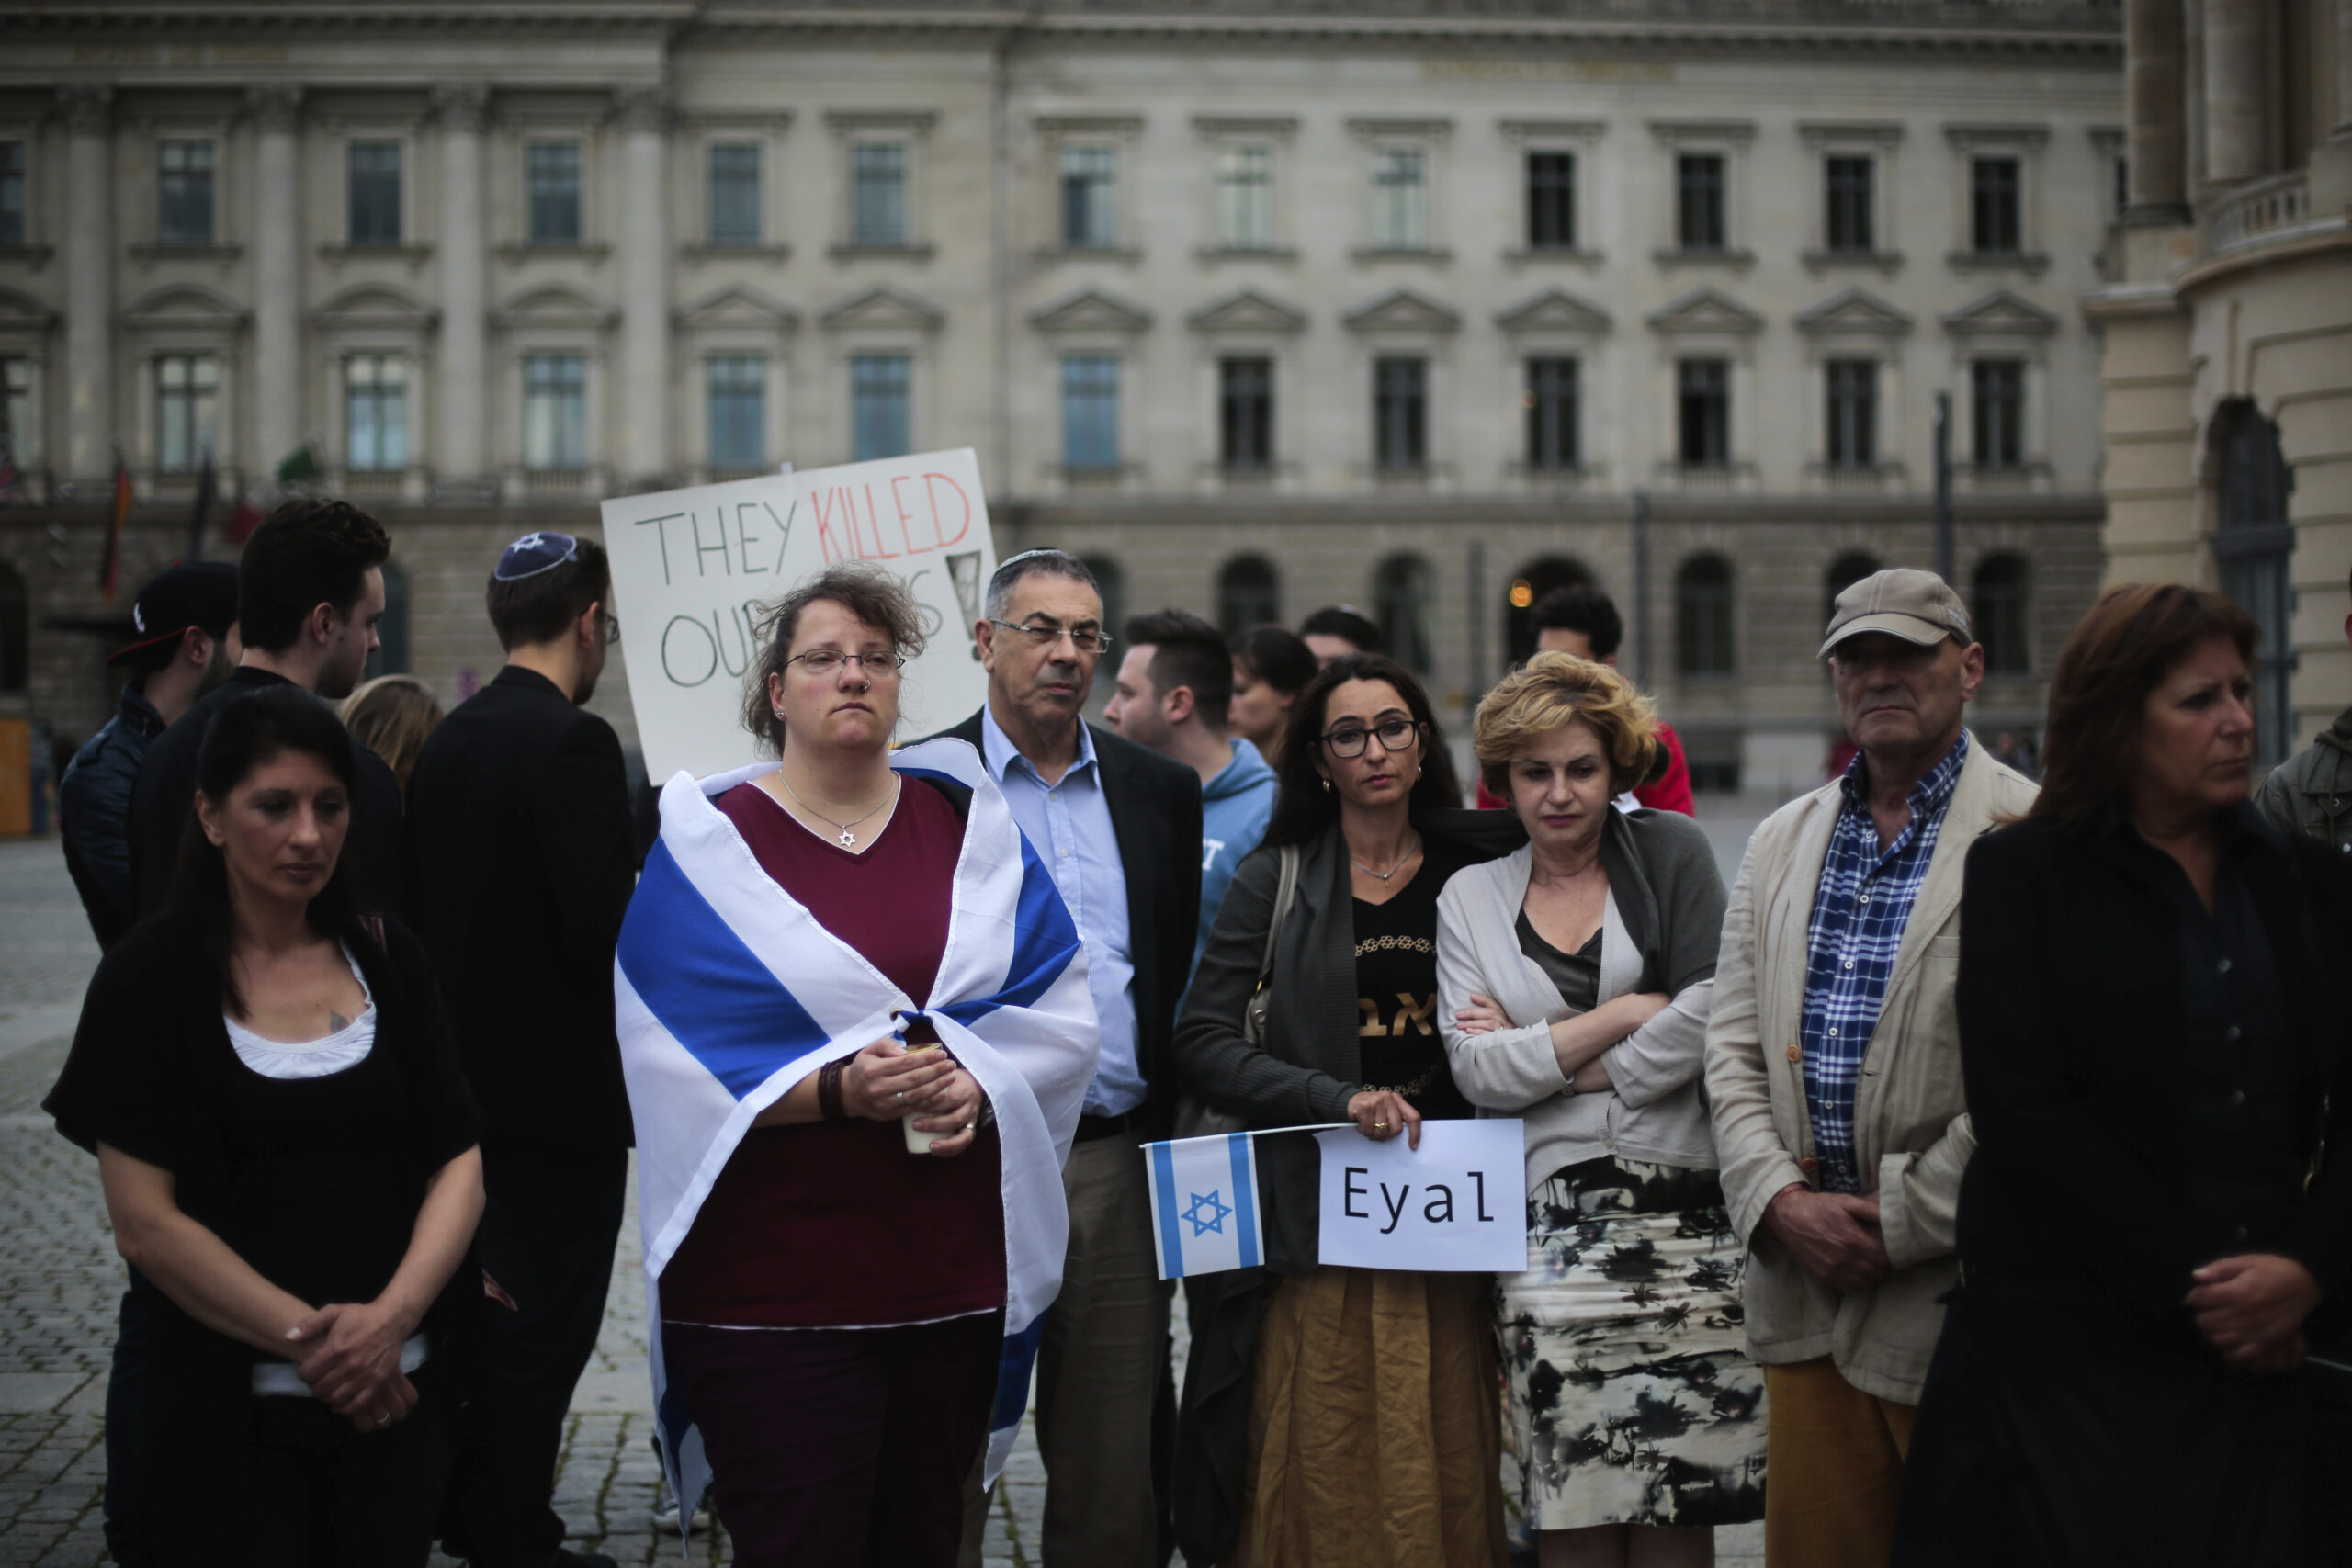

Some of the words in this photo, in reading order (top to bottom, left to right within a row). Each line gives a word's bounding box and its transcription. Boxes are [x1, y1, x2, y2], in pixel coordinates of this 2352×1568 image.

[634, 500, 797, 585] THEY
[812, 472, 971, 564] KILLED
[1344, 1166, 1495, 1235] Eyal
